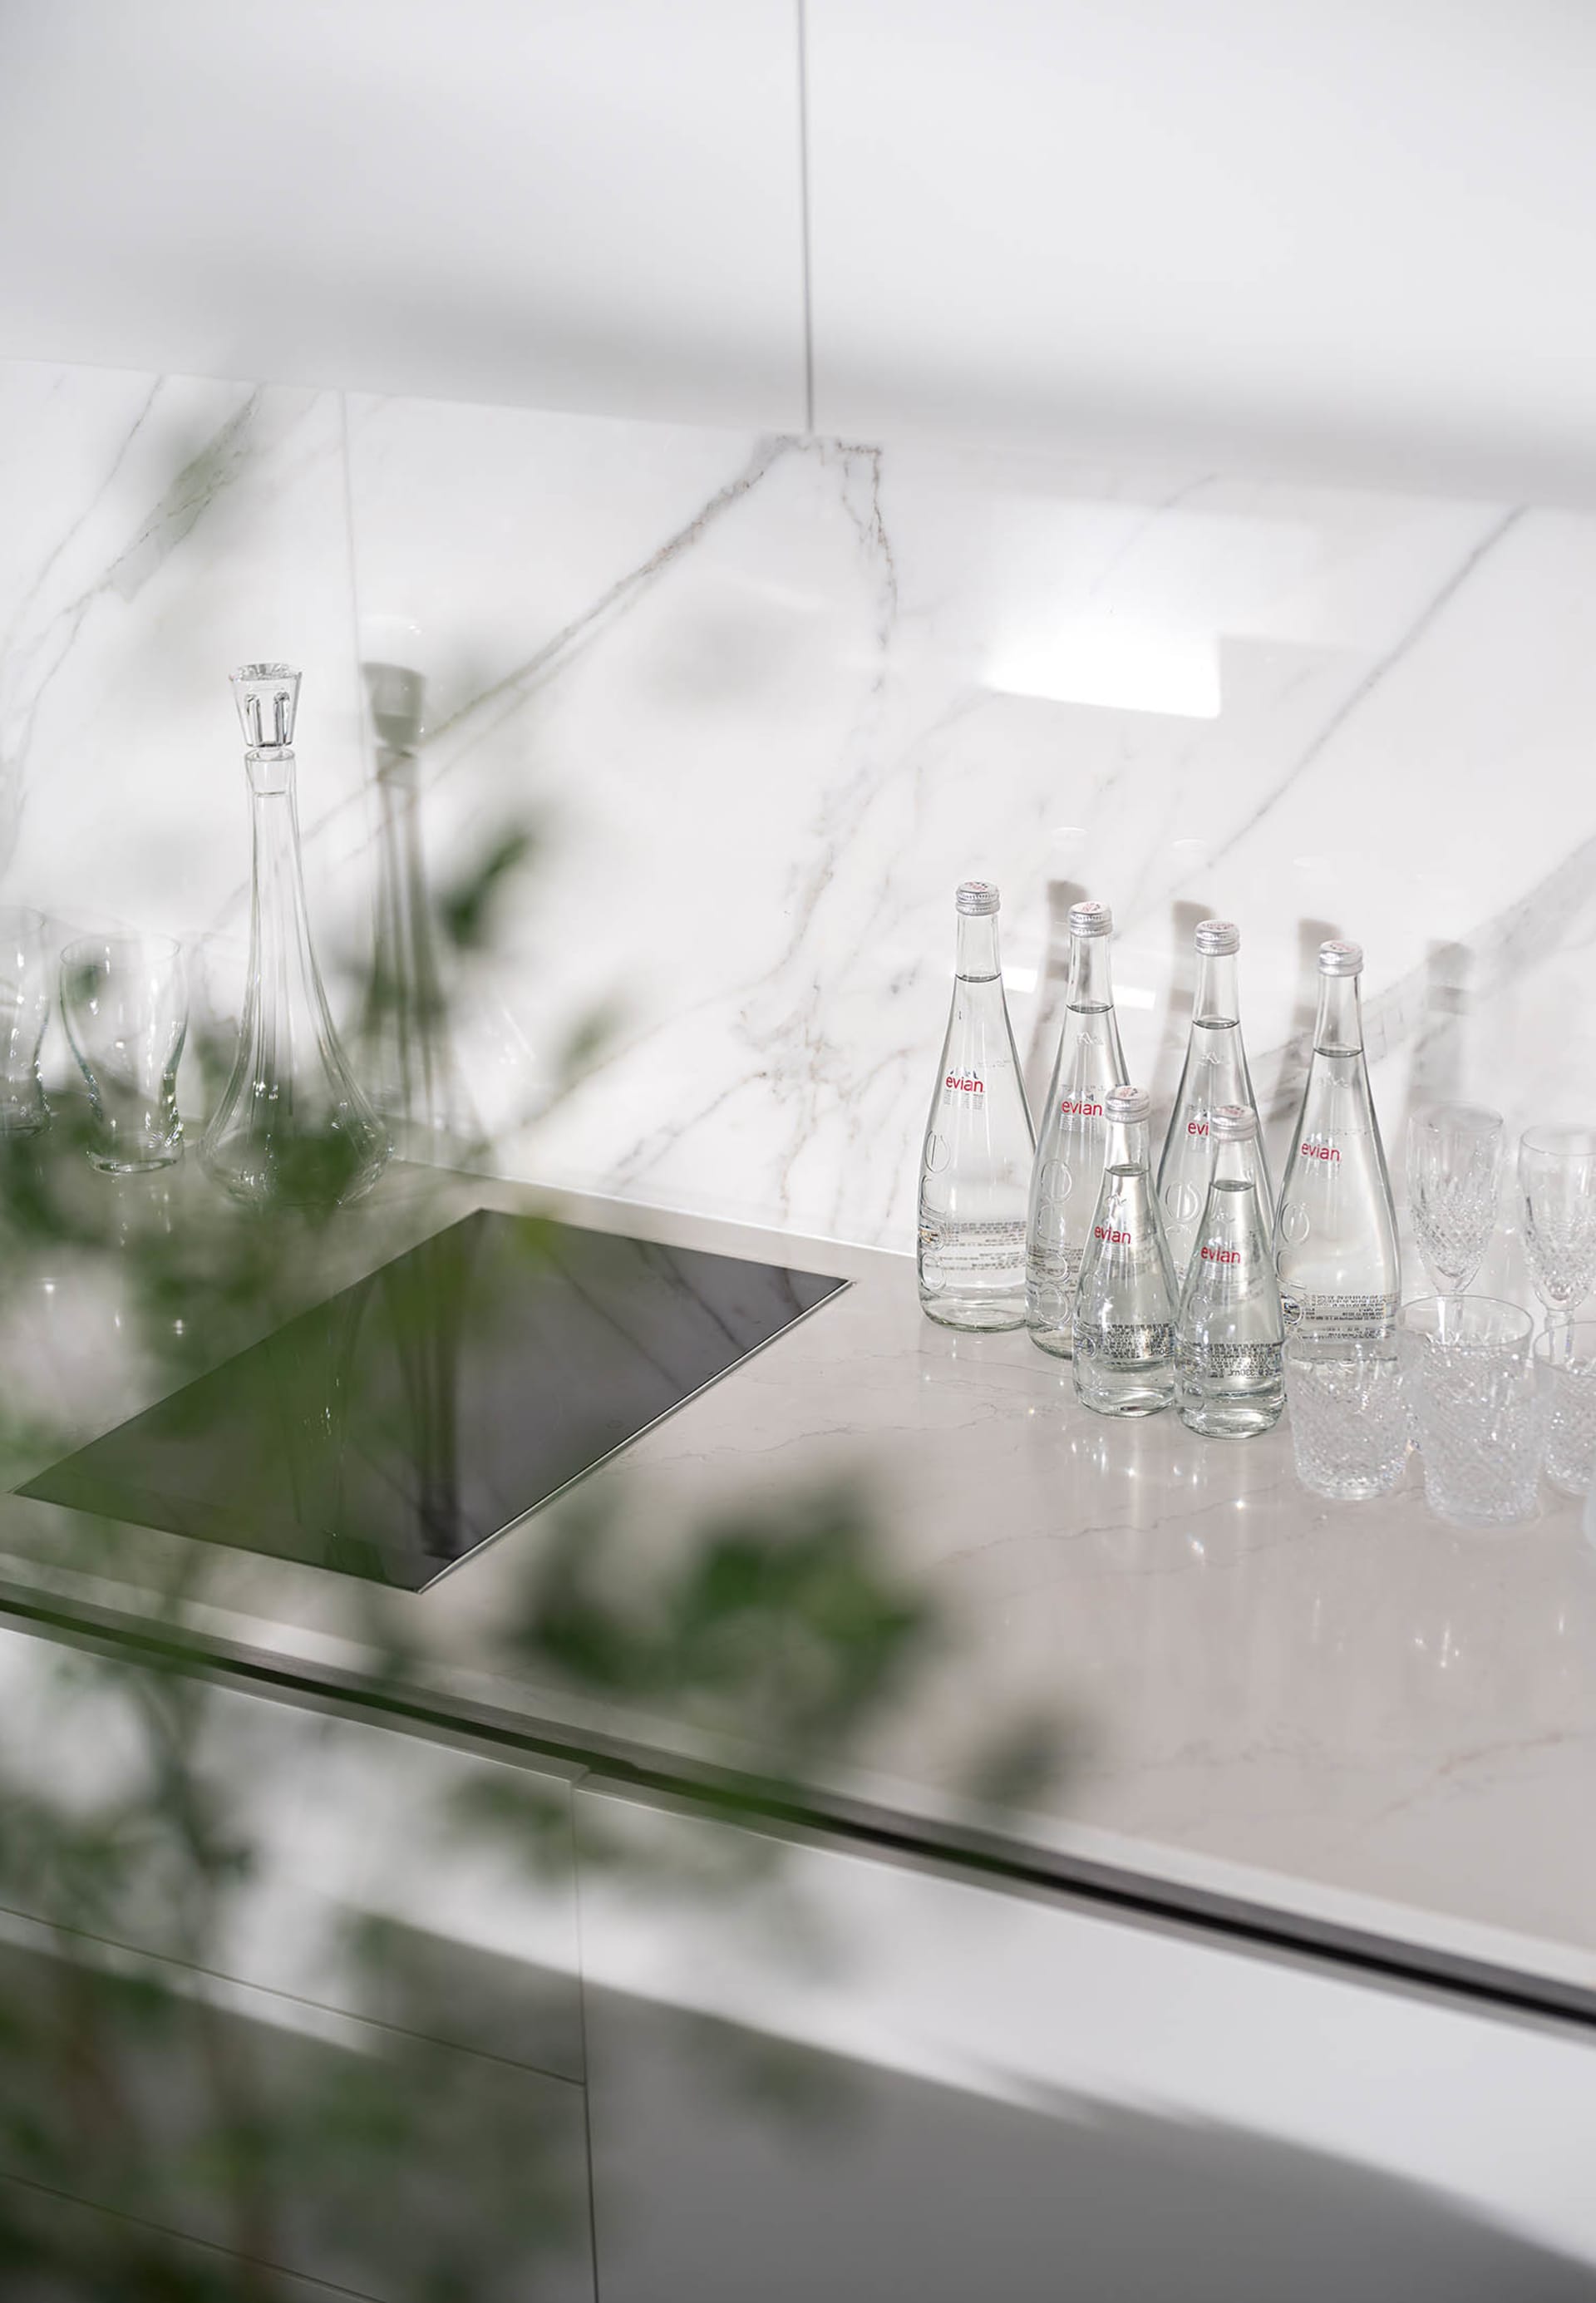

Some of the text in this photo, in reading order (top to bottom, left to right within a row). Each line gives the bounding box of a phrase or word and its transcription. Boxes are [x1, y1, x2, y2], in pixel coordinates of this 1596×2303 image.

[946, 1076, 983, 1092] evian
[1062, 1100, 1103, 1116] evian
[1188, 1122, 1209, 1136] evi
[1301, 1142, 1340, 1161] evian
[1094, 1225, 1131, 1244] evian
[1200, 1246, 1241, 1264] evian
